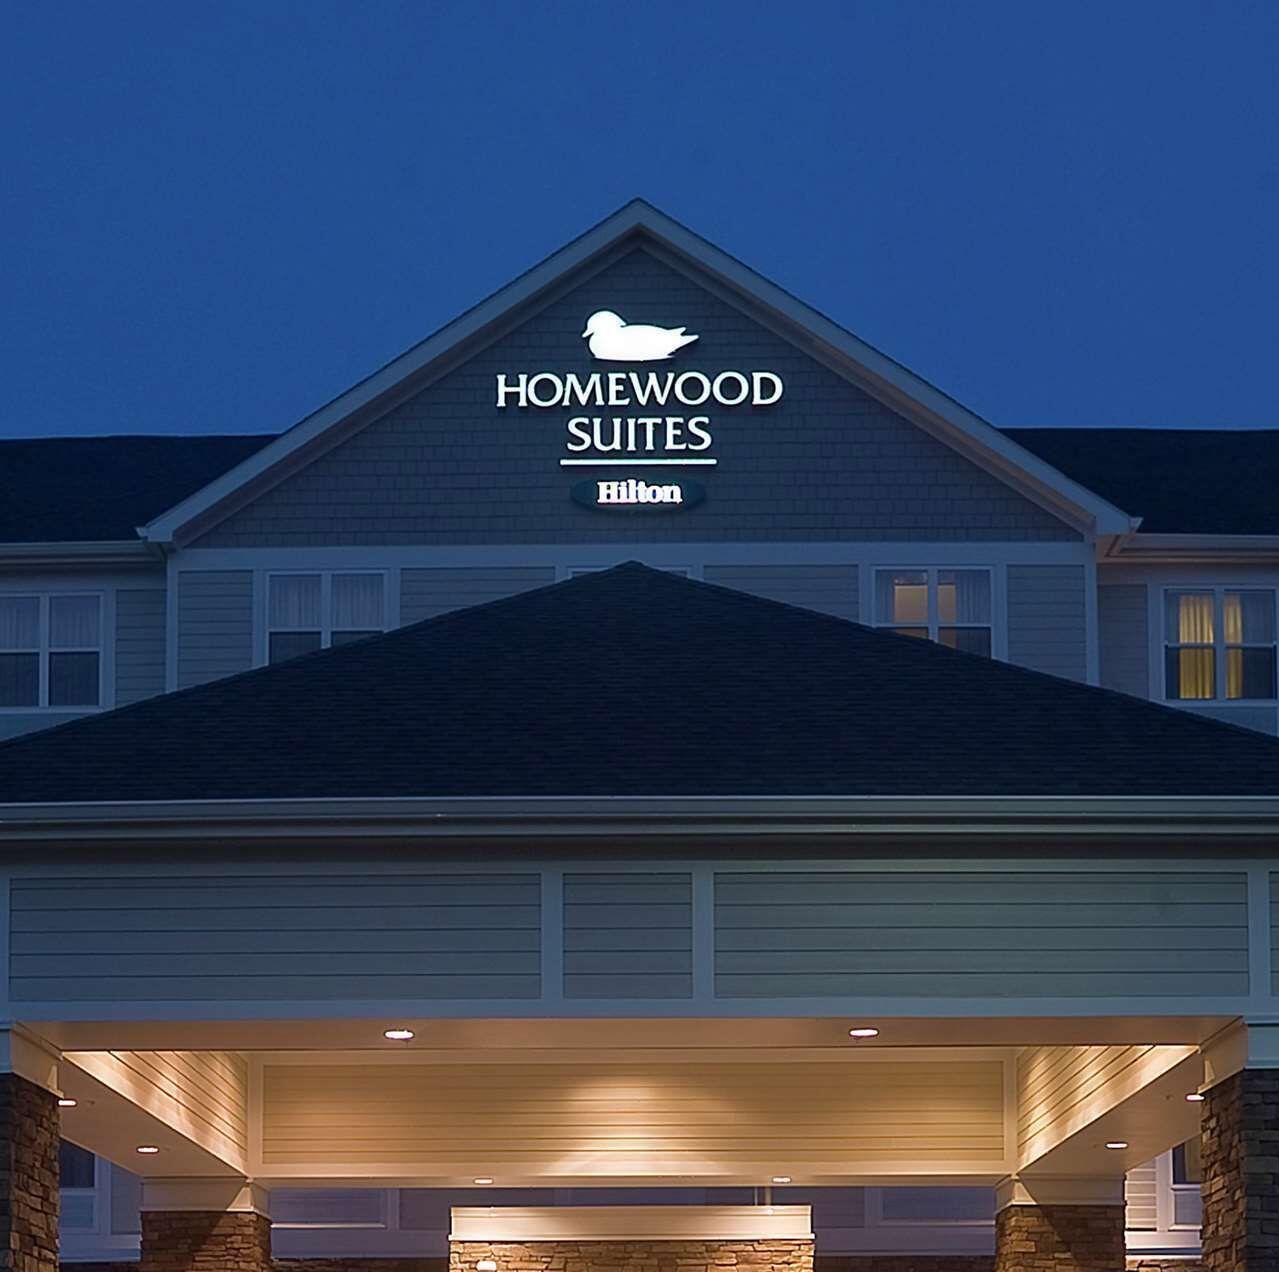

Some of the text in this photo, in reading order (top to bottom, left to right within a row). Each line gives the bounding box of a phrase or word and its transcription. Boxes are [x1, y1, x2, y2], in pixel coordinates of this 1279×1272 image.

[496, 371, 783, 407] HOMEWOOD
[567, 416, 712, 451] SUITES
[597, 479, 683, 504] Hilton
